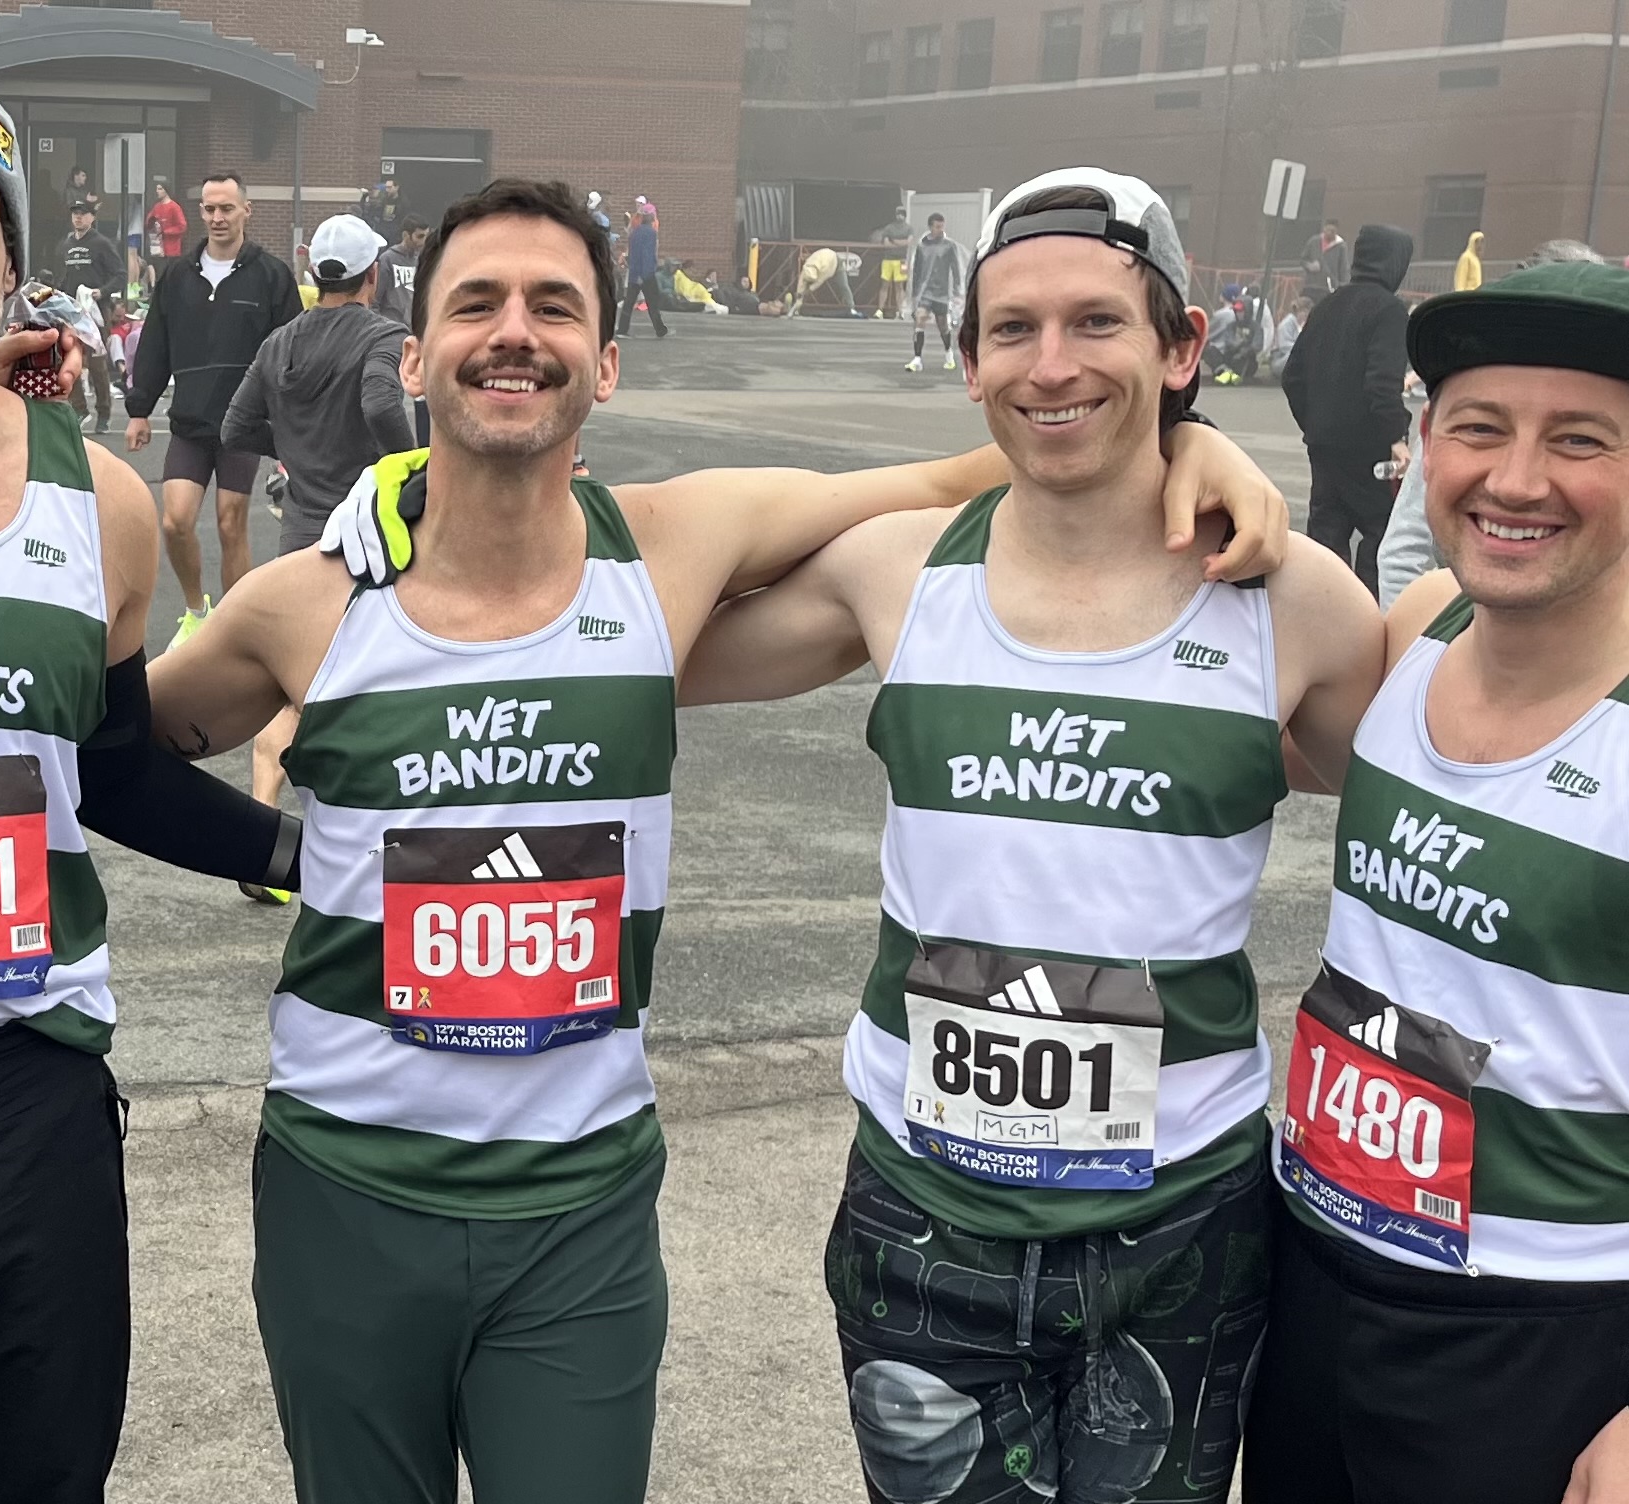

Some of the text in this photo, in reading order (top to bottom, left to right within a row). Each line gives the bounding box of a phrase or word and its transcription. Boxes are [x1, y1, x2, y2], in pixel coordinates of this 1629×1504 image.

[23, 538, 67, 563] Ultras
[578, 616, 625, 635] Ultras
[1173, 640, 1229, 665] Ultras
[446, 696, 552, 741] WET
[1009, 707, 1126, 757] WET
[392, 742, 600, 796] BANDITS
[947, 754, 1171, 816] BANDITS
[1546, 760, 1601, 794] Ultras
[1389, 808, 1485, 872] WET
[1347, 840, 1510, 944] BANDITS
[413, 898, 596, 978] 6055
[395, 991, 407, 1005] 7
[436, 1035, 526, 1048] MARATHON
[467, 1025, 525, 1036] BOSTON
[932, 1019, 1113, 1112] 8501
[916, 1098, 923, 1113] 1
[1306, 1044, 1443, 1179] 1480
[947, 1152, 1038, 1179] MARATHON
[977, 1149, 1037, 1166] BOSTON
[1319, 1182, 1362, 1213] BOSTON
